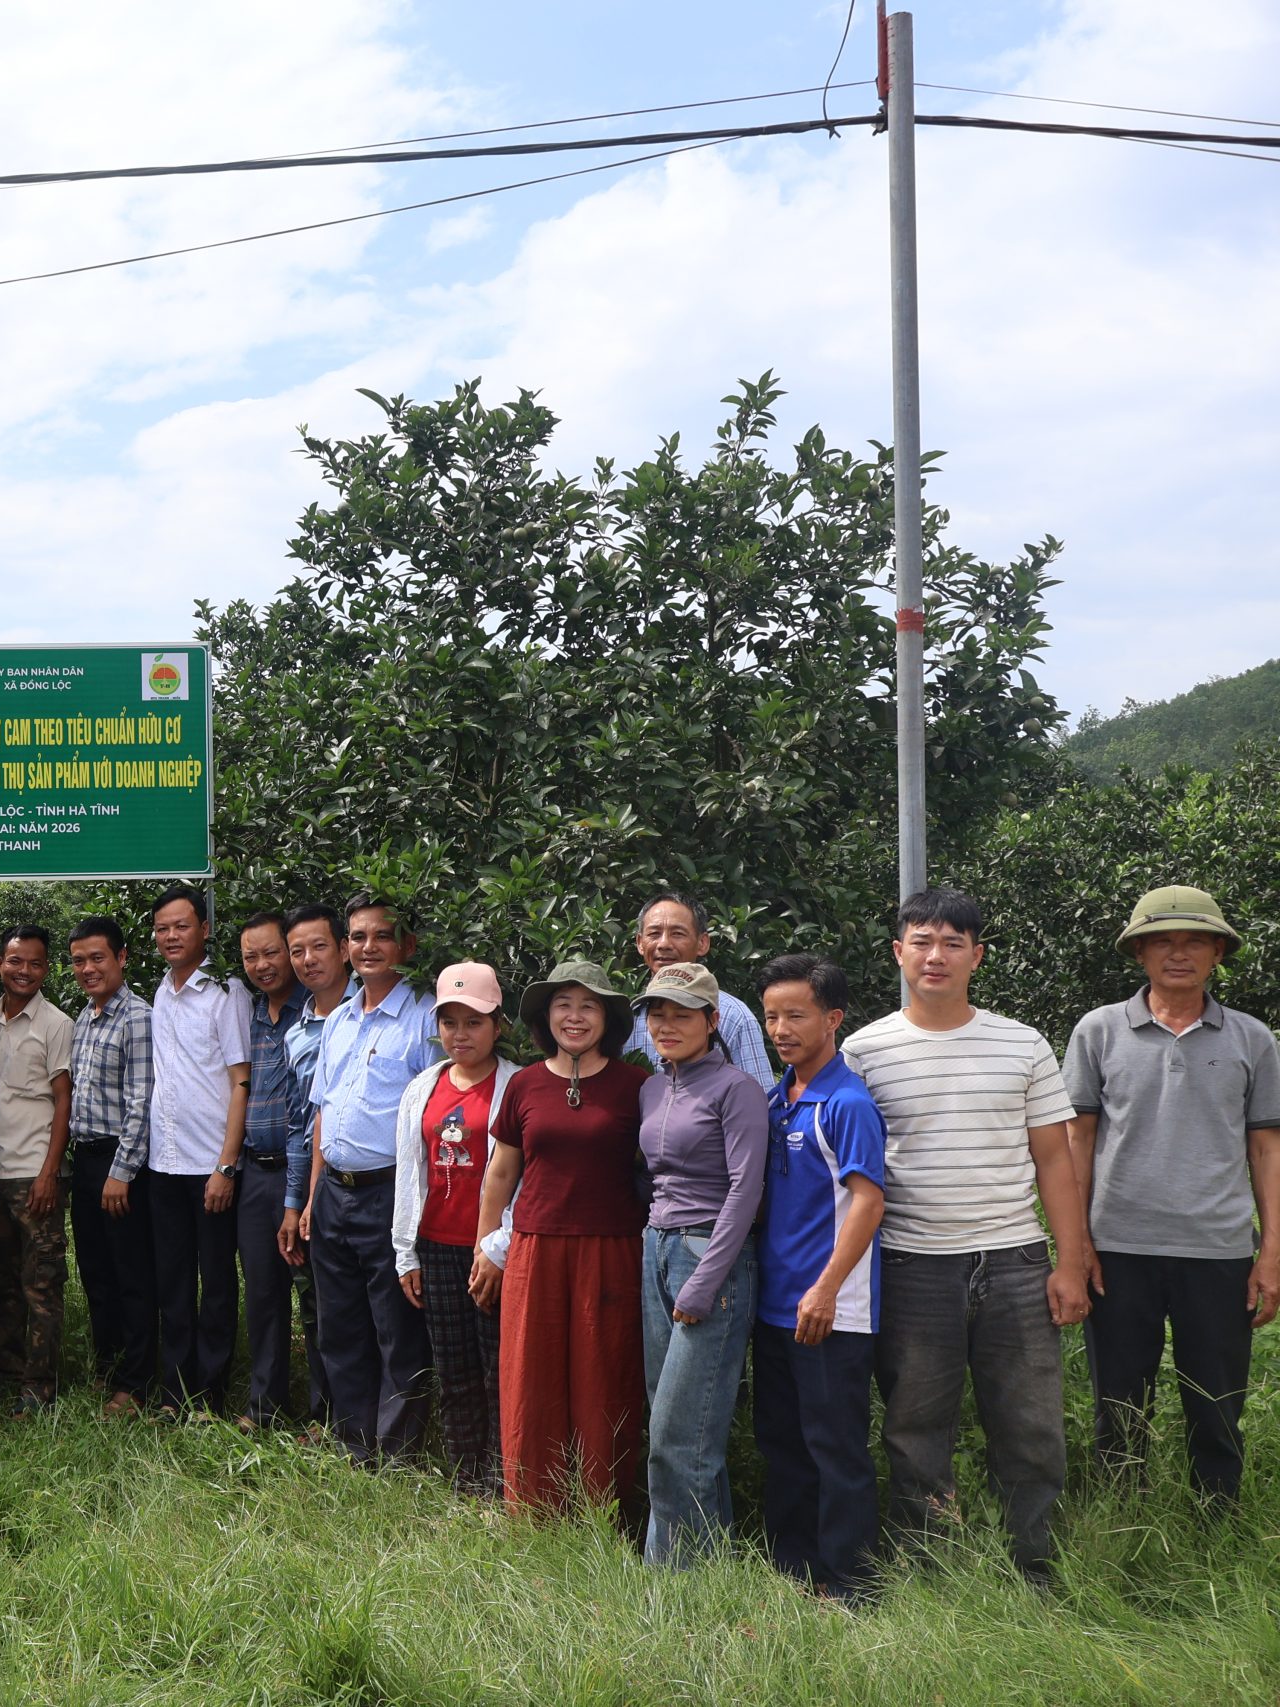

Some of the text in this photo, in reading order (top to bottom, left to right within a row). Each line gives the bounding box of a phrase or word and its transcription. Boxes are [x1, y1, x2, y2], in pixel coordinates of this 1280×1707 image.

[7, 667, 28, 676] BAN
[30, 665, 60, 676] NHÂN
[62, 665, 84, 676] DÂN
[4, 680, 18, 690] XÃ
[52, 680, 72, 691] LỘC
[4, 718, 31, 746] CAM
[34, 718, 63, 745] THEO
[66, 712, 92, 745] TIÊU
[95, 706, 135, 745] CHUẨN
[138, 712, 162, 744] HỮU
[165, 714, 181, 744] CƠ
[2, 762, 25, 795] THỤ
[28, 753, 52, 789] SẢN
[55, 750, 90, 789] PHẨM
[93, 755, 112, 789] VỚI
[115, 760, 155, 788] DOANH
[158, 754, 202, 793] NGHIỆP
[0, 804, 25, 819] LỘC
[36, 803, 65, 816] TỈNH
[68, 803, 87, 816] HÀ
[90, 803, 120, 816] TĨNH
[19, 821, 48, 833] NĂM
[51, 823, 81, 833] 2026
